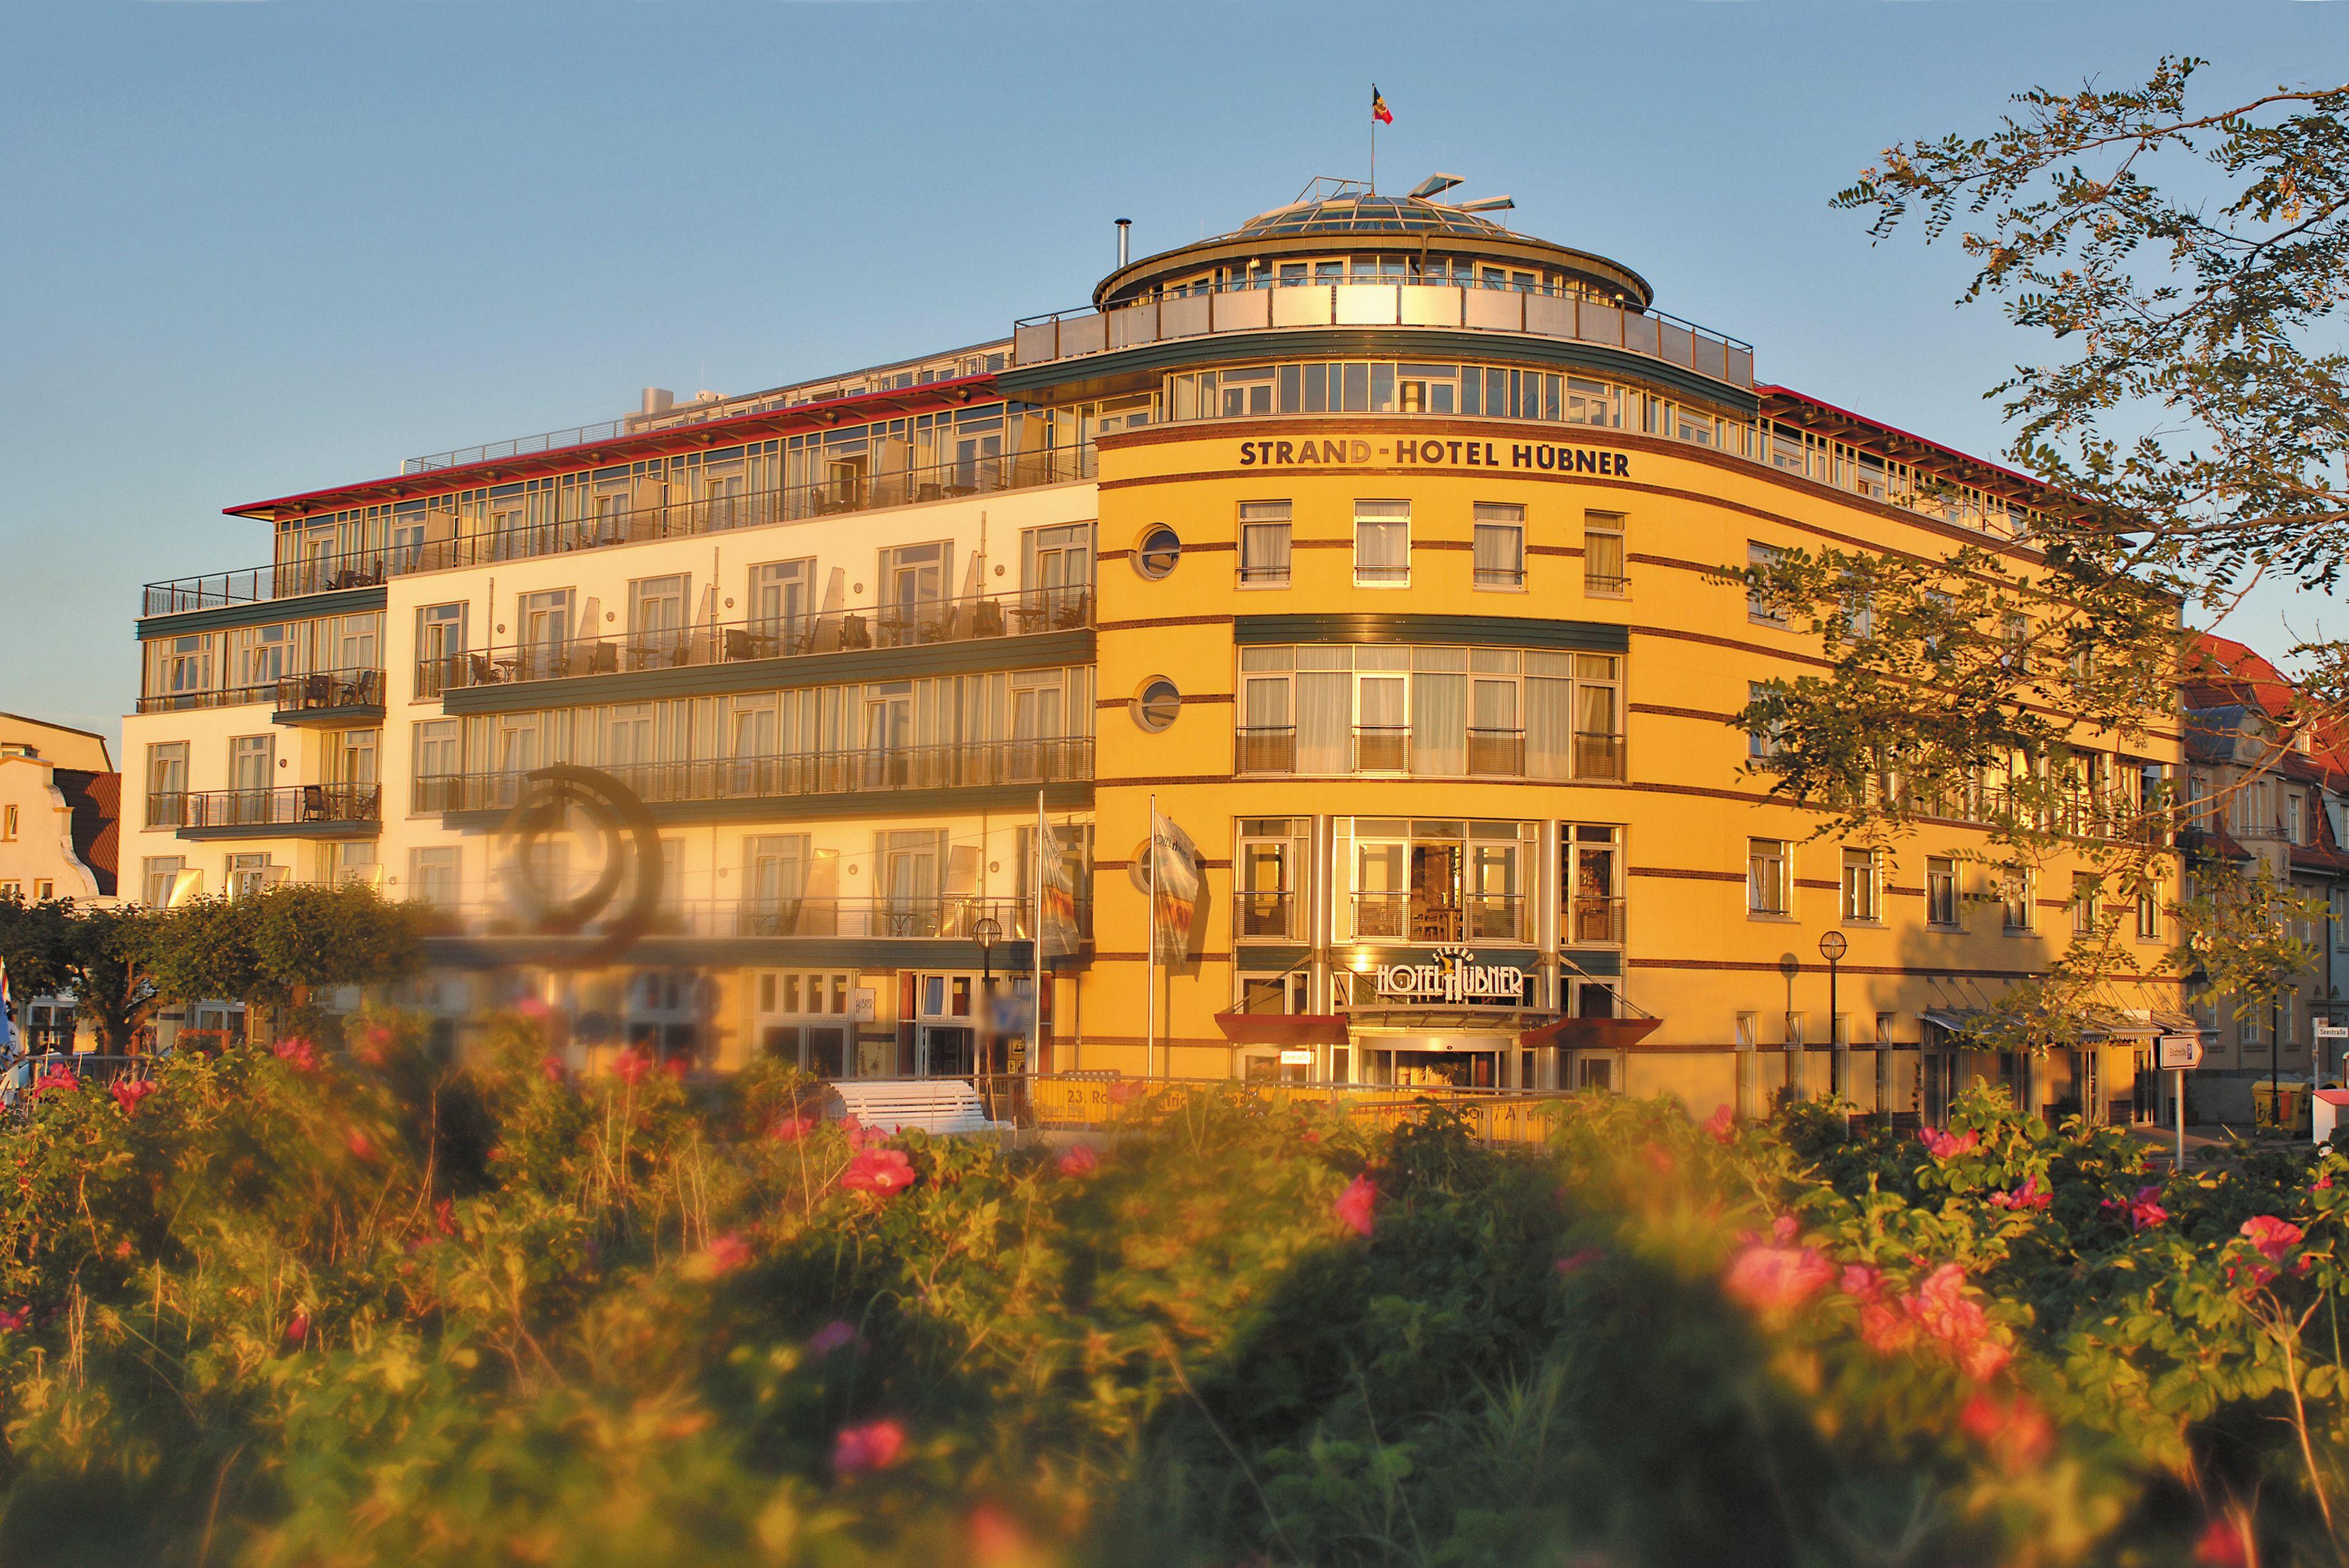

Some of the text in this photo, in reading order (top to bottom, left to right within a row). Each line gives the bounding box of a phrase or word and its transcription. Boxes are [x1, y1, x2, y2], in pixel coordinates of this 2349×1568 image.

[1512, 442, 1630, 478] HÜBNER
[1432, 945, 1475, 962] STRAND
[1376, 959, 1523, 1001] HOTEL HÜBNER
[1067, 1090, 1086, 1104] 23.
